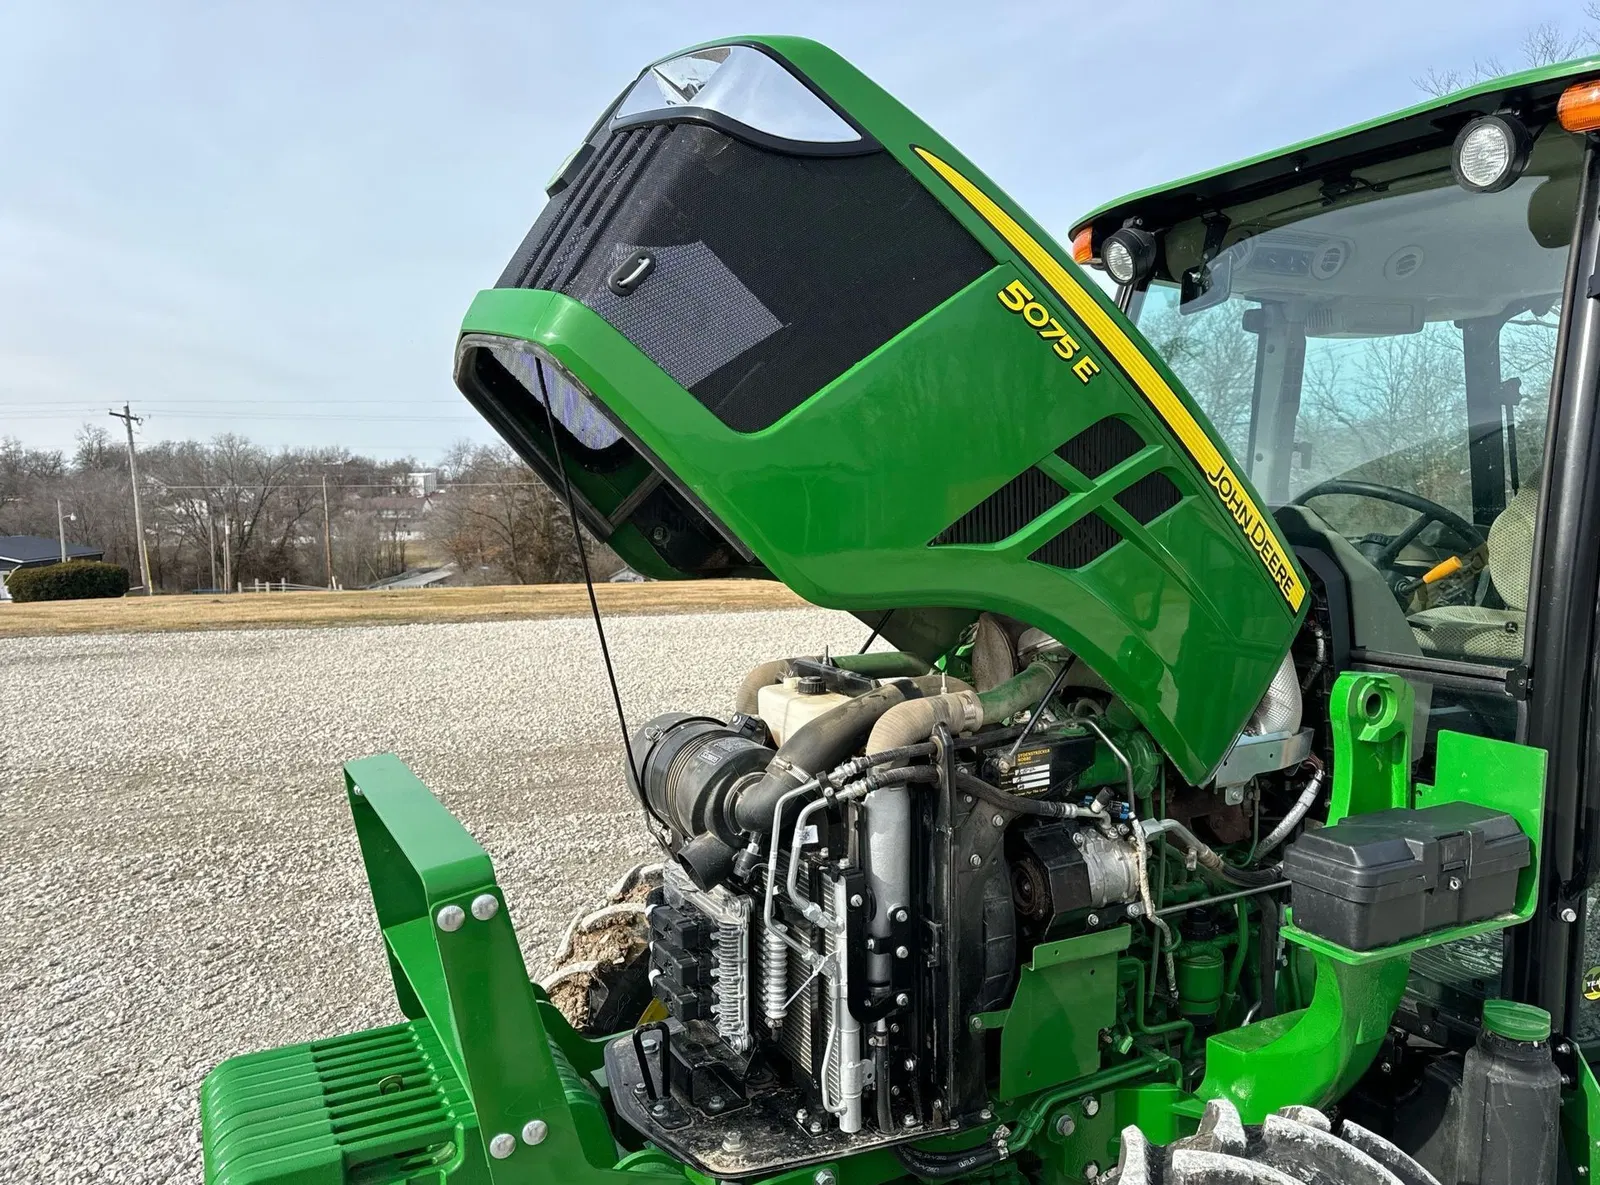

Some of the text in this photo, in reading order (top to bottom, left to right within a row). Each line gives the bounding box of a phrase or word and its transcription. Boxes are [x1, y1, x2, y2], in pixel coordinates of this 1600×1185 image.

[997, 279, 1080, 361] 5075
[1207, 466, 1295, 598] JOHN DEERE
